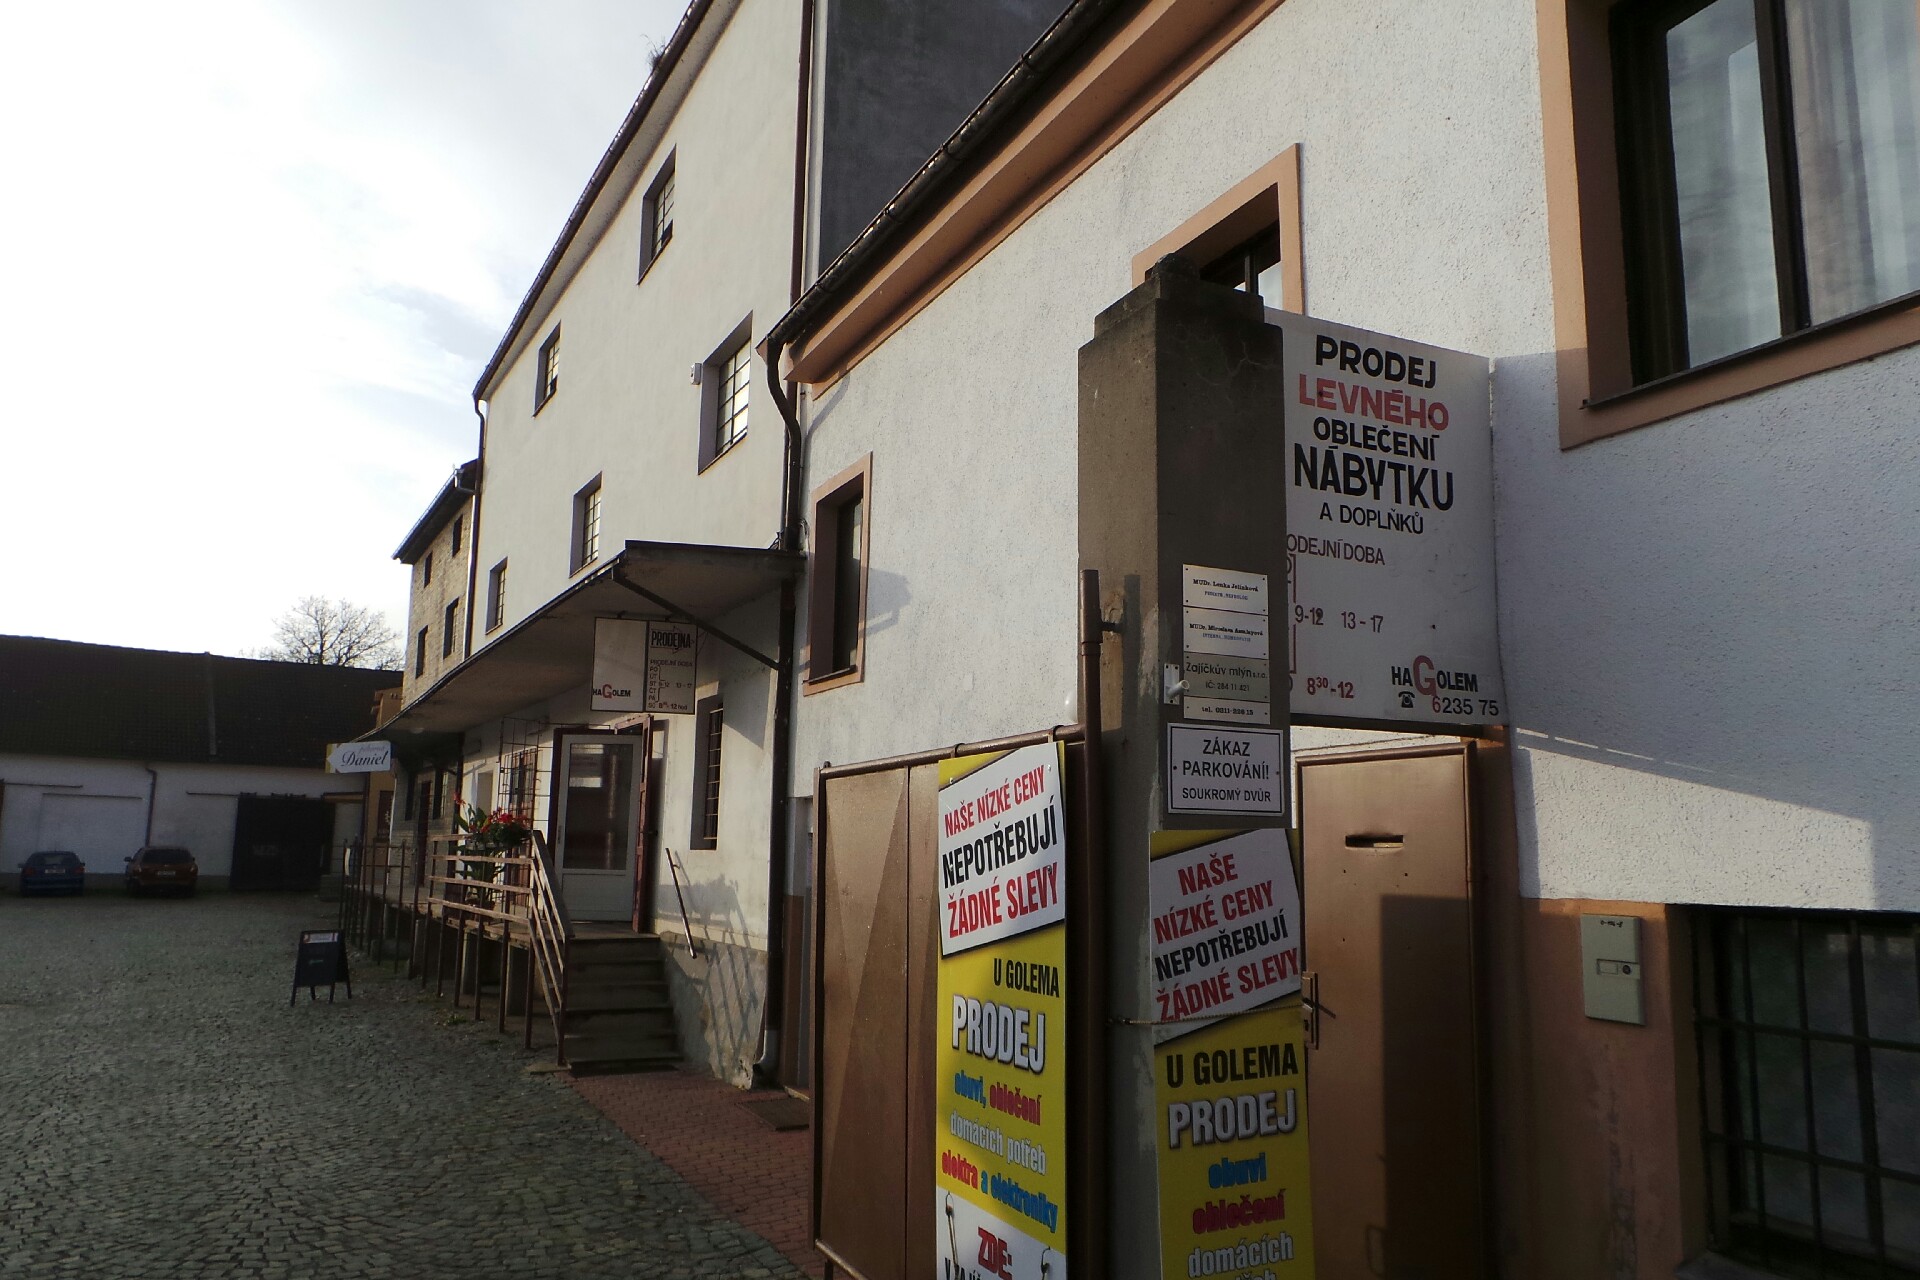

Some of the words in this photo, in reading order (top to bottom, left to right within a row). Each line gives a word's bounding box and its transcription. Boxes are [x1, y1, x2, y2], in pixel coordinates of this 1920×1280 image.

[1315, 334, 1436, 389] PRODEJ
[1299, 373, 1449, 431] LEVNÉHO
[1313, 416, 1440, 461] OBLEČENÍ
[1294, 442, 1454, 511] NÁBYTKU
[1319, 502, 1333, 521] A
[1339, 504, 1424, 535] DOPLŇKŮ
[1287, 533, 1343, 559] ODEJNÍ
[1343, 542, 1386, 566] DOBA
[651, 630, 692, 650] PRODEJNA
[1229, 667, 1253, 679] mlýn
[1478, 699, 1499, 716] 75
[341, 750, 389, 767] Daniel
[1202, 736, 1251, 757] ZÁKAZ
[1182, 760, 1269, 780] PARKOVÁNÍ!
[944, 799, 974, 838] NAŠE
[976, 777, 1012, 823] NÍZKÉ
[1014, 764, 1045, 806] CENY
[1182, 787, 1241, 801] SOUKROMÝ
[1243, 787, 1271, 802] DVŮR
[942, 795, 1058, 889] NEPOTŘEBUJÍ
[1177, 852, 1239, 896] NAŠE
[947, 876, 1002, 939] ŽÁDNÉ
[1005, 861, 1058, 920] SLEVY
[1153, 894, 1219, 944] NÍZKÉ
[1221, 880, 1274, 921] CENY
[1154, 908, 1289, 982] NEPOTŘEBUJÍ
[993, 958, 1002, 986] U
[1005, 960, 1060, 998] GOLEMA
[1156, 966, 1235, 1022] ŽÁDNÉ
[1236, 947, 1299, 994] SLEVY
[952, 994, 1046, 1075] PRODEJ
[1166, 1054, 1184, 1088] U
[1193, 1043, 1298, 1085] GOLEMA
[989, 1081, 1042, 1126] oblečení
[1168, 1088, 1298, 1149] PRODEJ
[950, 1109, 1003, 1157] domácích
[1007, 1136, 1046, 1176] potřeb
[941, 1149, 978, 1190] elektra
[980, 1170, 989, 1195] a
[990, 1172, 1058, 1234] elektroniky
[1208, 1152, 1268, 1189] obuvi
[1192, 1188, 1287, 1235] oblečení
[1187, 1231, 1294, 1278] domácích
